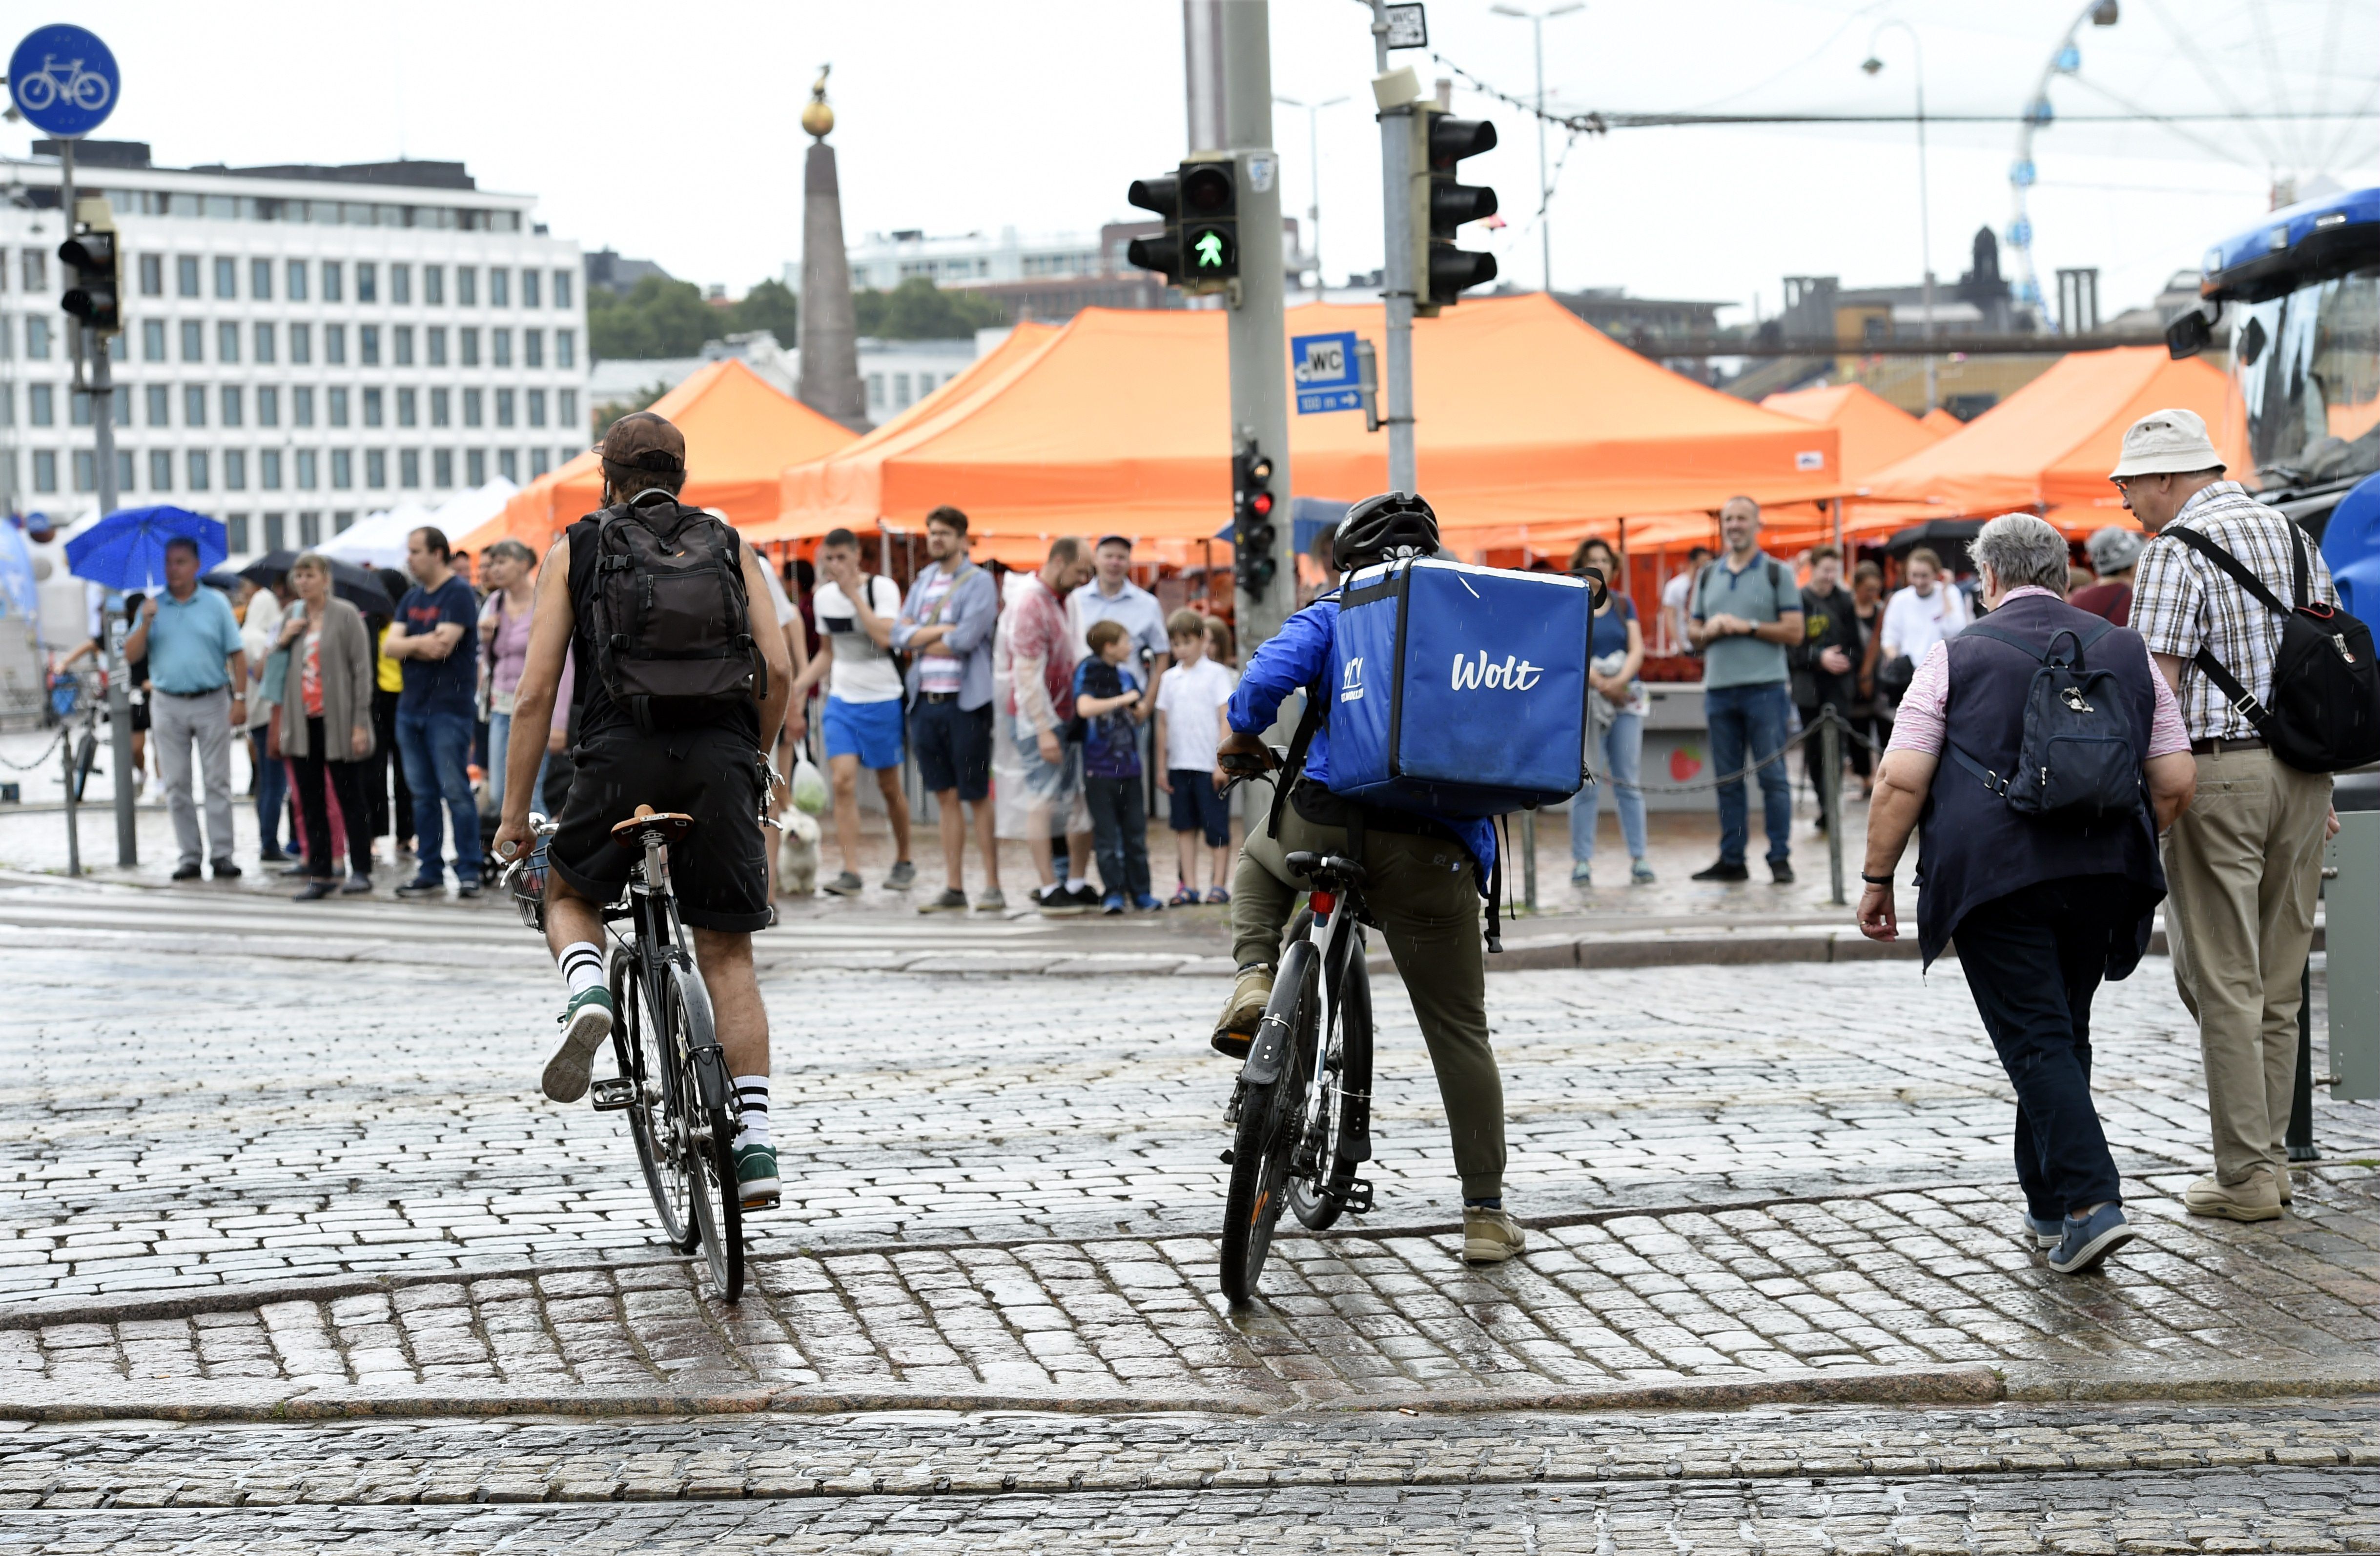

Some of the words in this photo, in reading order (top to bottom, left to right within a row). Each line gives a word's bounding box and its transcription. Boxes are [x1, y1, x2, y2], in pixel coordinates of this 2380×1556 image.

[1309, 350, 1342, 371] WC
[1302, 396, 1322, 410] 100
[1323, 397, 1337, 409] m
[1451, 650, 1544, 691] Wolt
